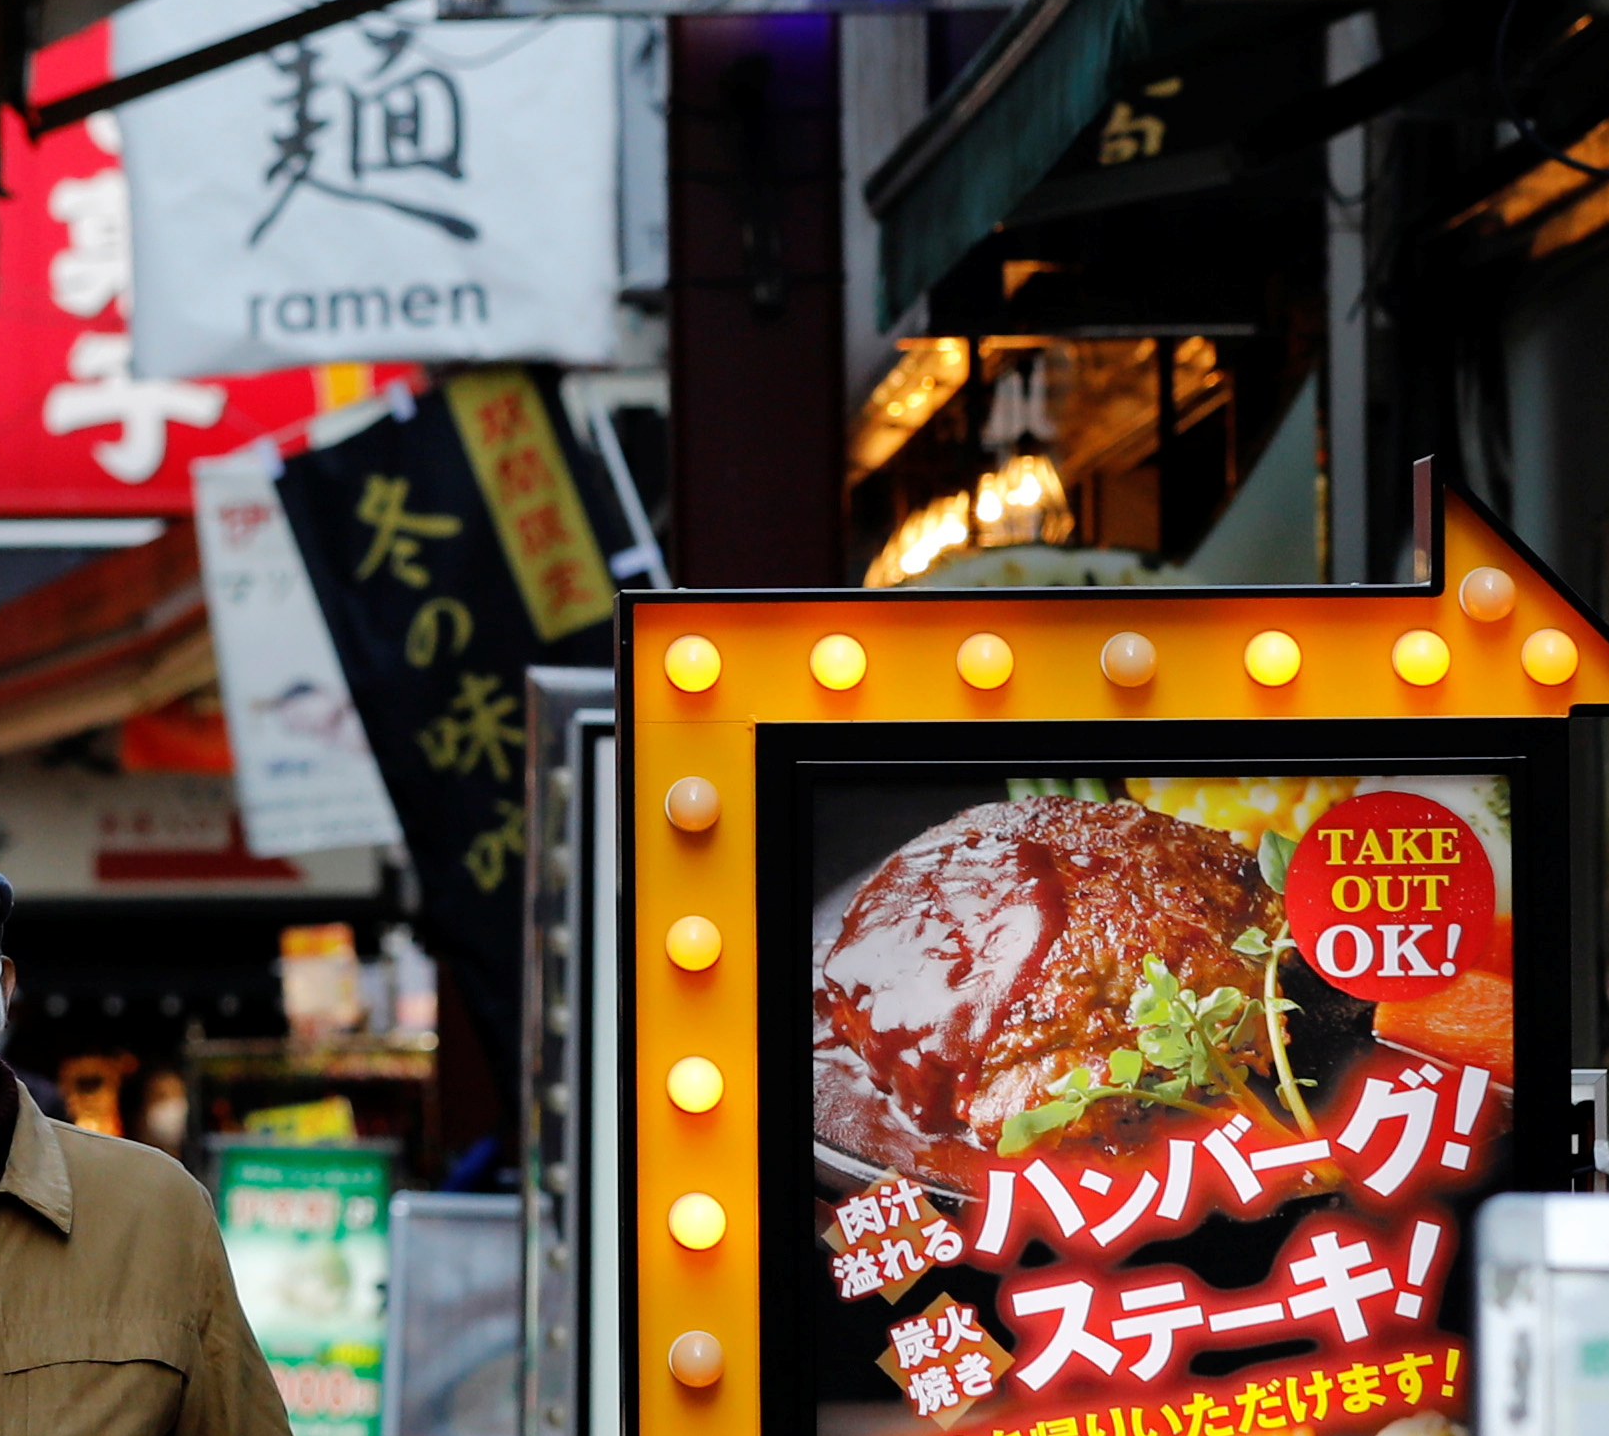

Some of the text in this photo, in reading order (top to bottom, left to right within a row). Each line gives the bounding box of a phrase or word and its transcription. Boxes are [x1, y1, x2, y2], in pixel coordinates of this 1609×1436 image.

[247, 277, 490, 343] ramen
[1317, 829, 1460, 865] TAKE
[1331, 875, 1450, 913] OUT
[1315, 926, 1460, 978] OK!
[975, 1063, 1493, 1258] ハンバーグ!
[836, 1179, 924, 1245] 肉汁
[832, 1219, 963, 1302] 溢れる
[889, 1302, 978, 1366] 炭火
[1012, 1220, 1442, 1394] ステーキ!
[906, 1348, 995, 1418] 焼き
